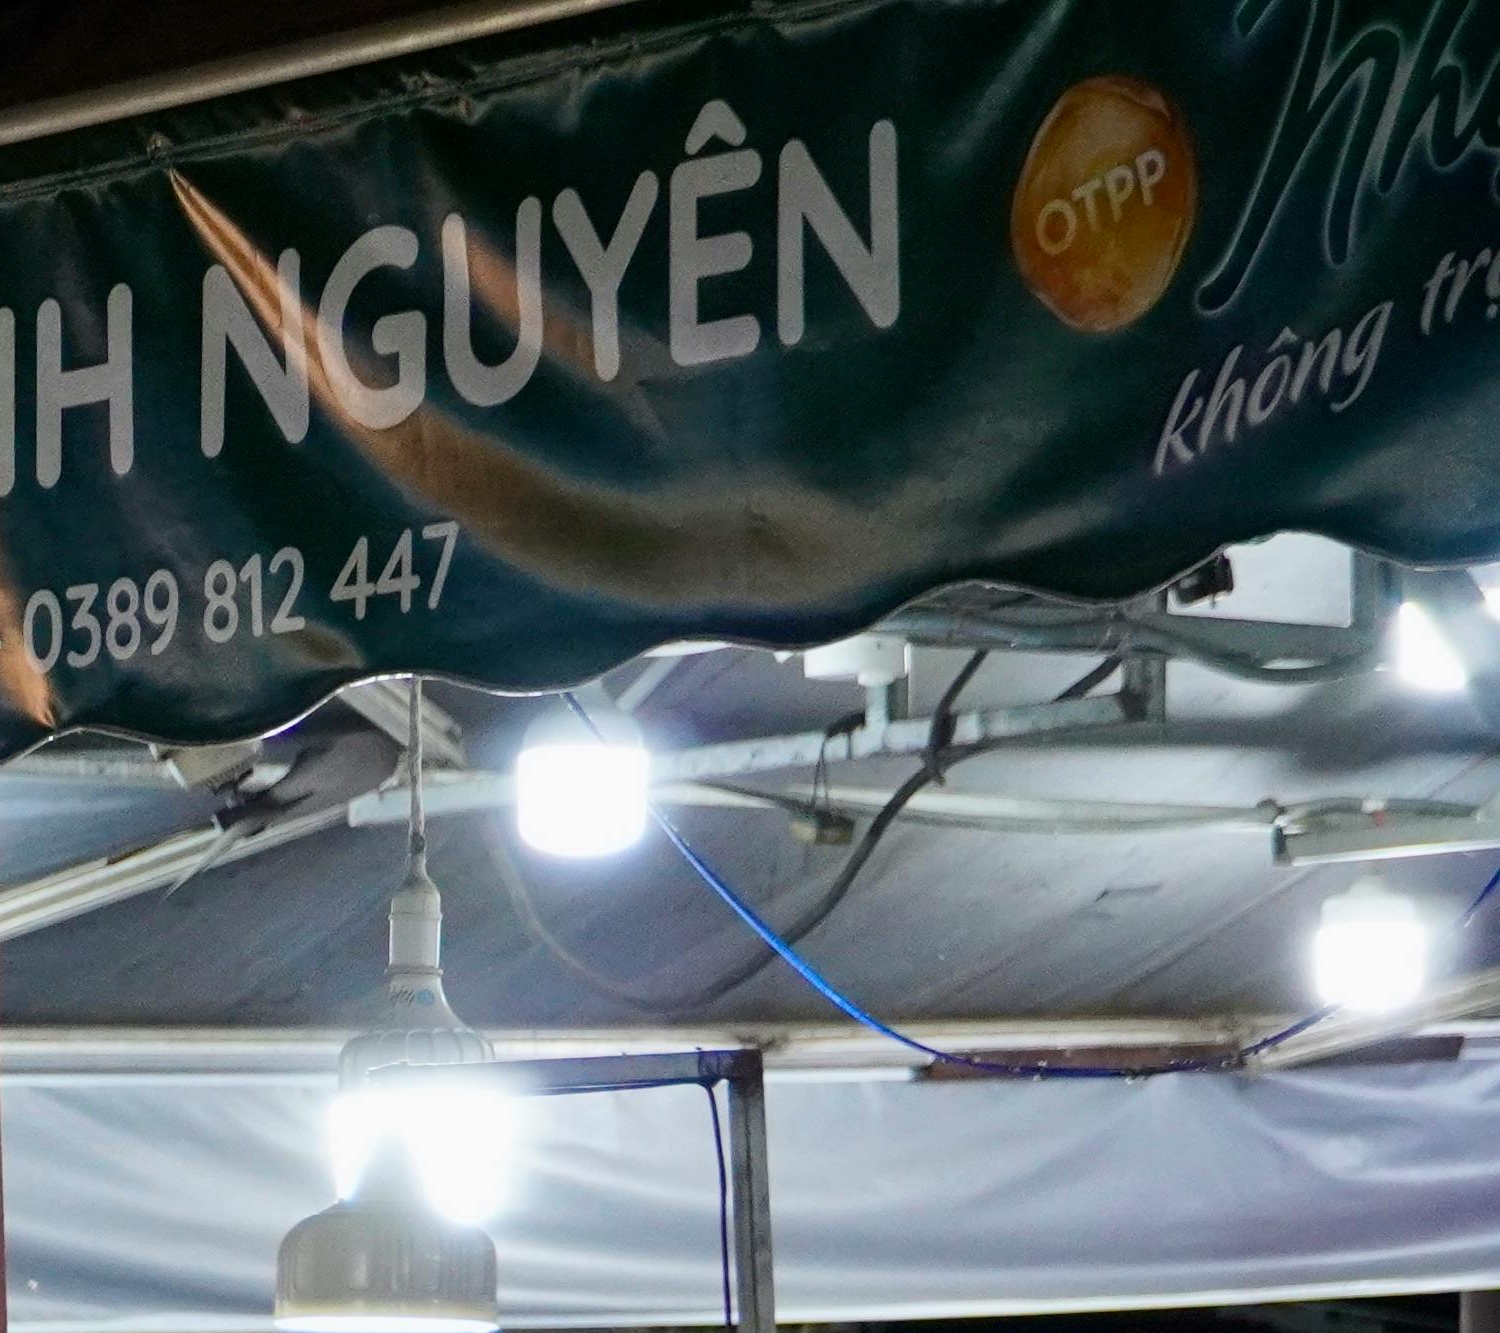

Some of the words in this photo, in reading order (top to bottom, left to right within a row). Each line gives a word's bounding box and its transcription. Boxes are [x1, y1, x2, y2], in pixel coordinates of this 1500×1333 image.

[200, 99, 900, 459] NGUYÊN
[1035, 149, 1167, 256] OTPP
[1153, 302, 1394, 477] không
[22, 569, 179, 674] 0389
[203, 546, 305, 643] 812
[329, 519, 460, 621] 447
